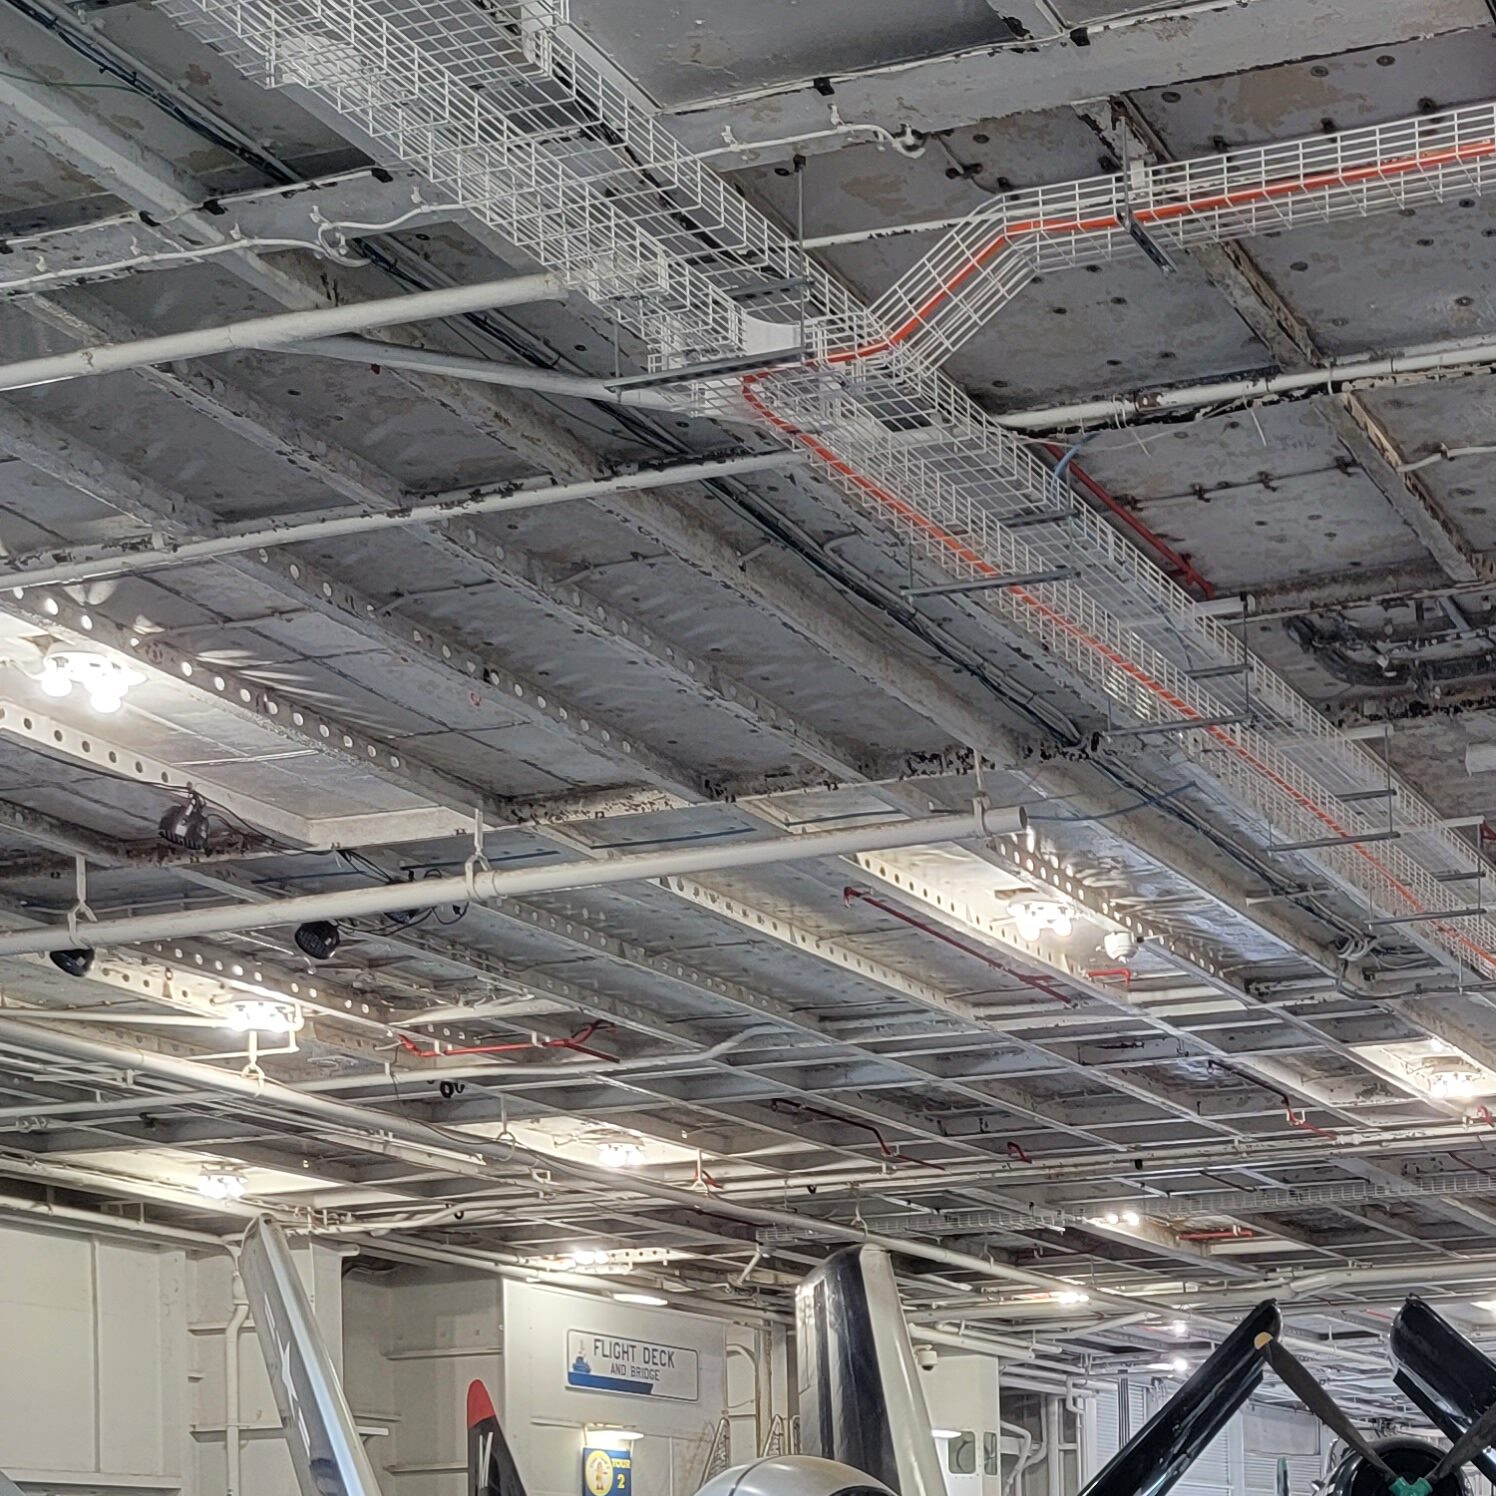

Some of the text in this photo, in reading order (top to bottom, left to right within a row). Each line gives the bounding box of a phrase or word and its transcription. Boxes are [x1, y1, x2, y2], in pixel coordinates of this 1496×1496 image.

[593, 1339, 675, 1369] FLIGHT DECK
[611, 1364, 660, 1381] AND BRIDGE
[617, 1474, 625, 1489] 2
